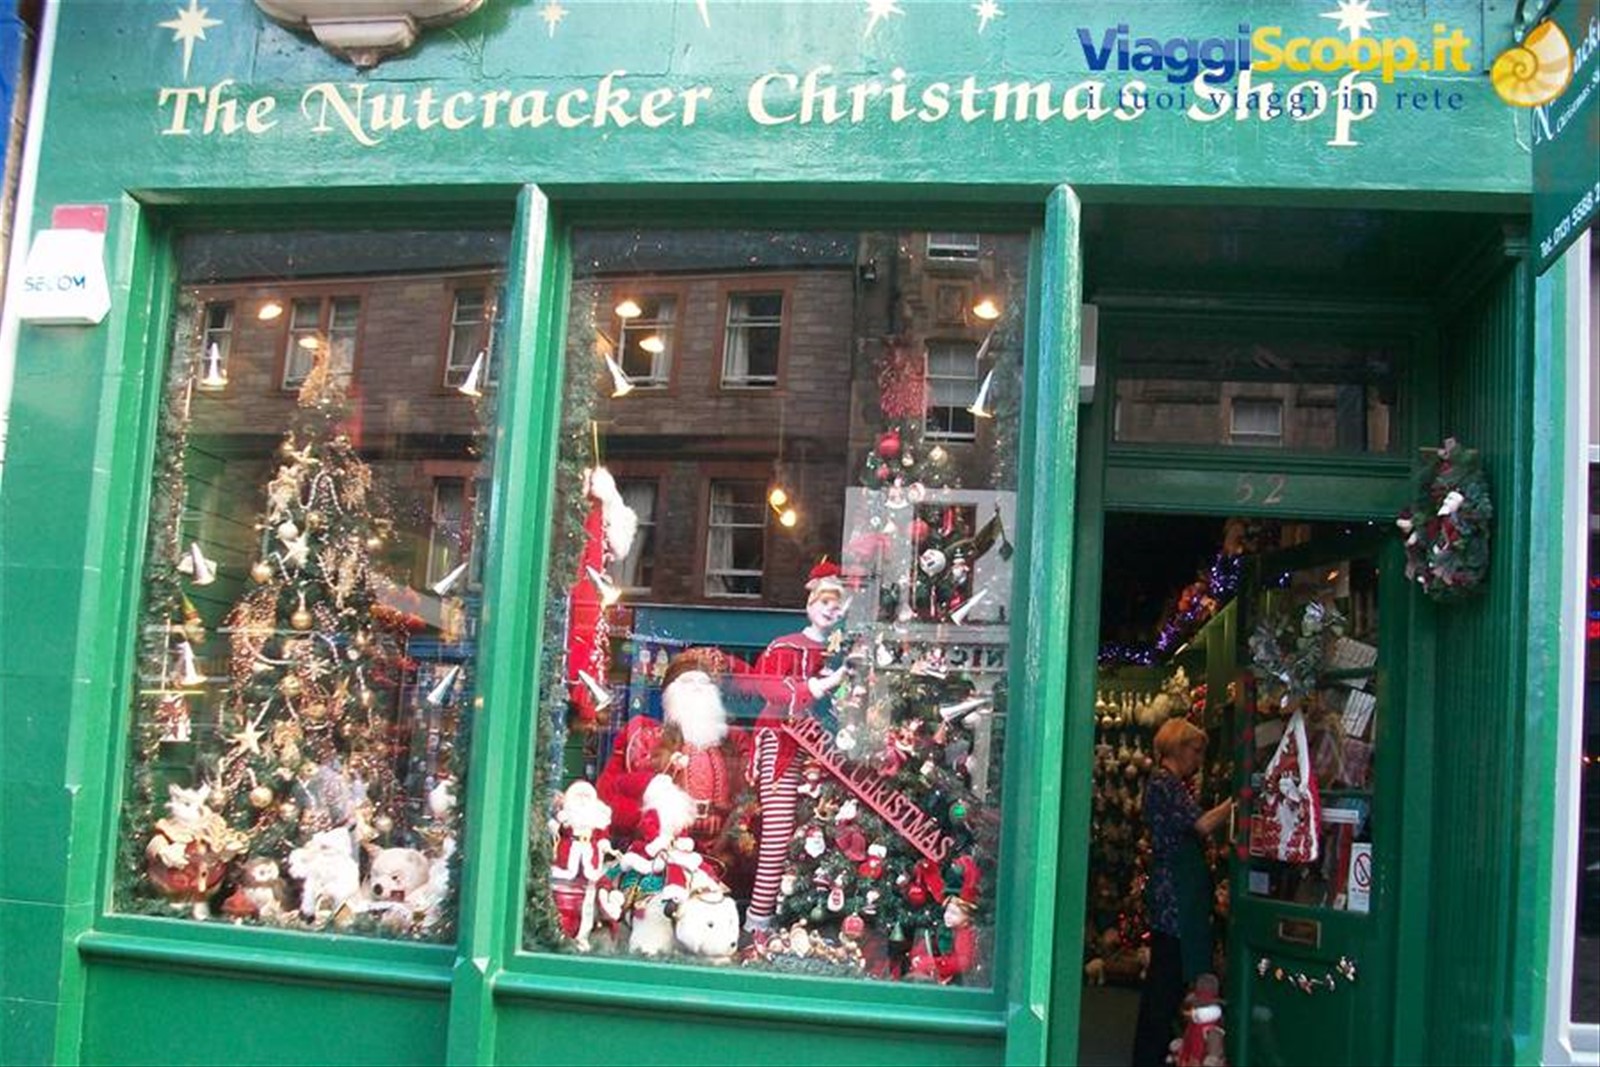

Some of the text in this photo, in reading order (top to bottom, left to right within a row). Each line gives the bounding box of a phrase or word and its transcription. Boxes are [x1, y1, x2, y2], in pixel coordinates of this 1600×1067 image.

[157, 61, 1377, 147] The Nutcracker Christmas Shop
[23, 274, 87, 292] SEOM
[785, 716, 955, 862] MERRY CHRISTMAS
